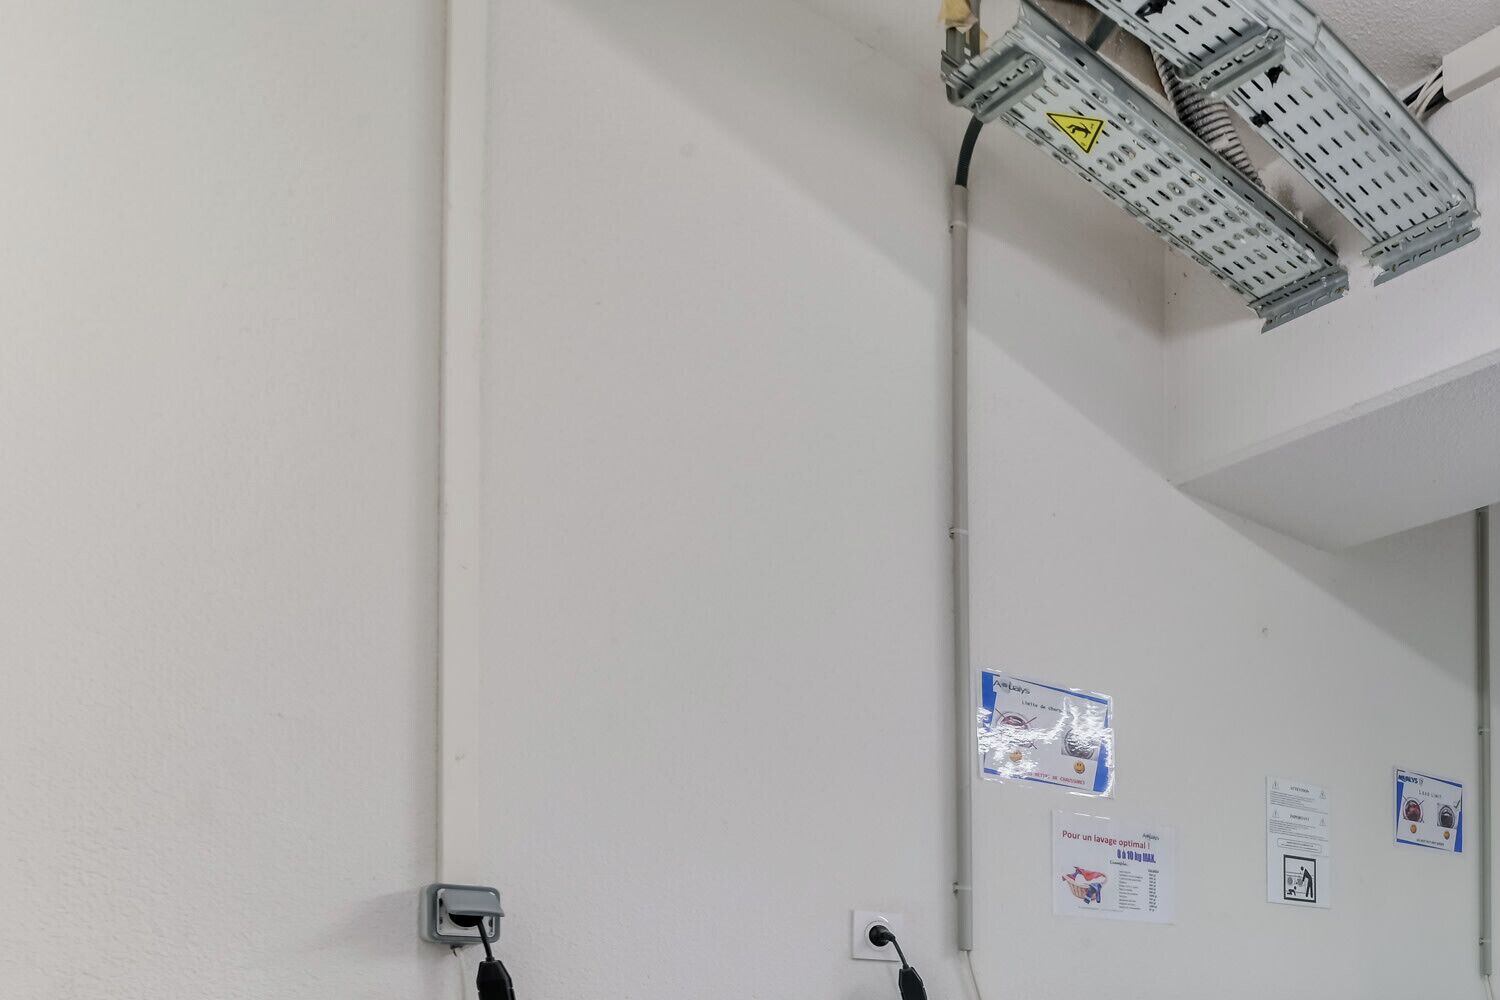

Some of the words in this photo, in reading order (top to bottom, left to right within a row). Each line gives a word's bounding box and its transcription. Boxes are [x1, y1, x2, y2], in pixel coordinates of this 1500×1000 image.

[1062, 830, 1081, 840] Pour
[1093, 834, 1117, 847] lavage
[1118, 839, 1146, 850] optimal
[1127, 850, 1134, 860] 10
